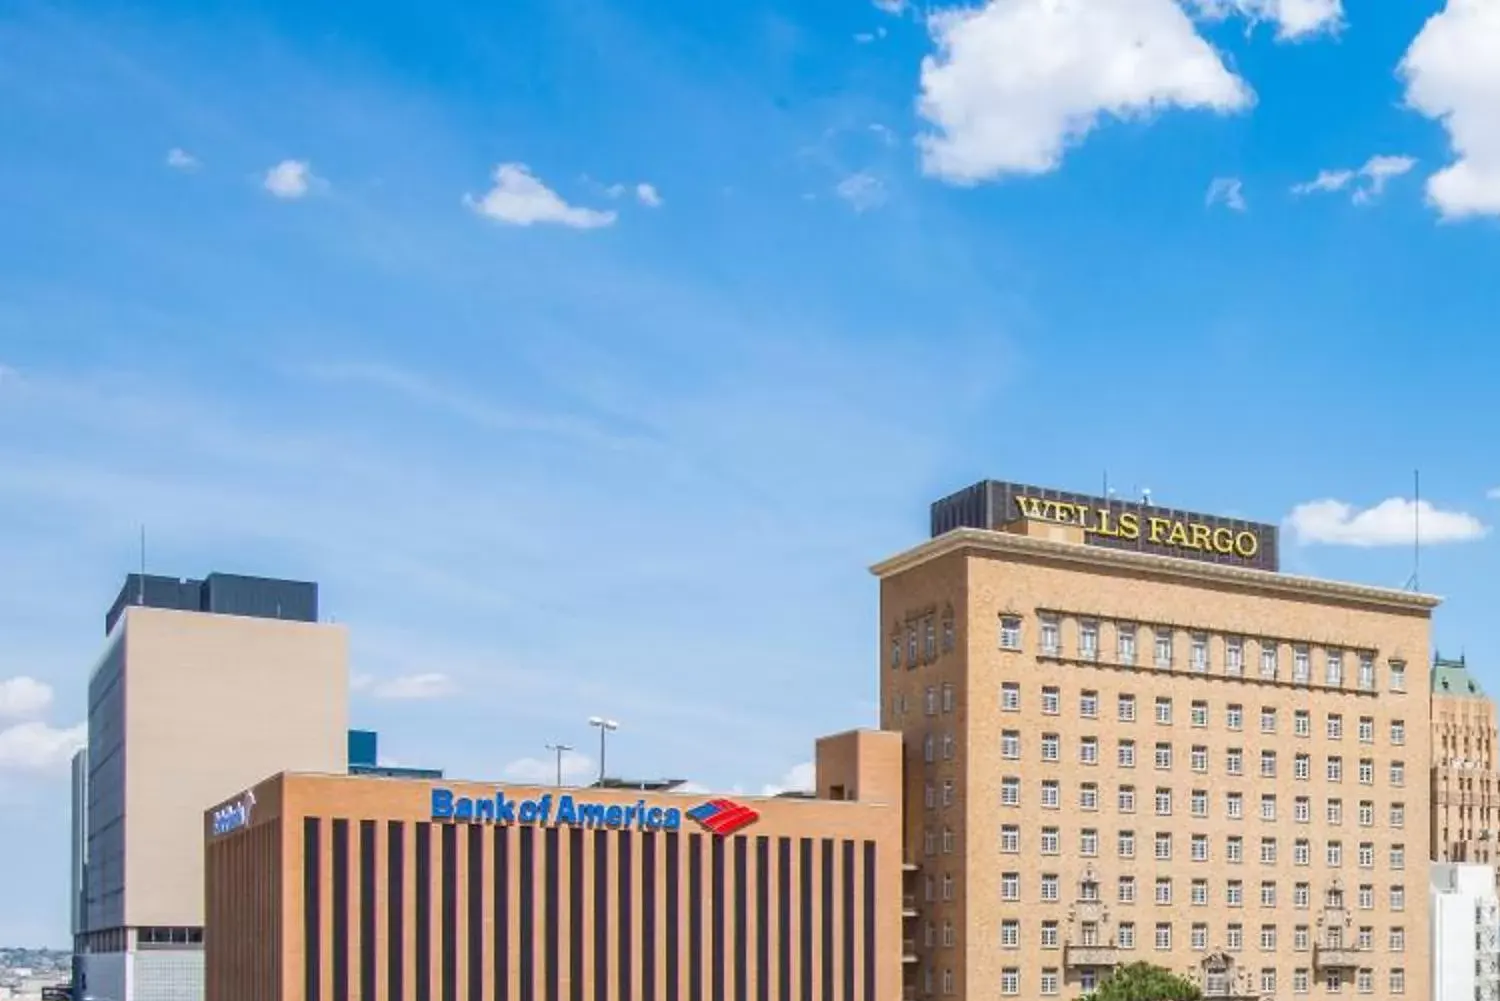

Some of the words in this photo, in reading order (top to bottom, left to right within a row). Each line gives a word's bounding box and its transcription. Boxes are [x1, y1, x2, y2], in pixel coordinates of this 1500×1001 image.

[1016, 495, 1140, 540] WELLS
[1148, 516, 1257, 557] FARGO
[431, 788, 515, 824] Bank
[518, 793, 552, 827] of
[555, 794, 681, 831] America
